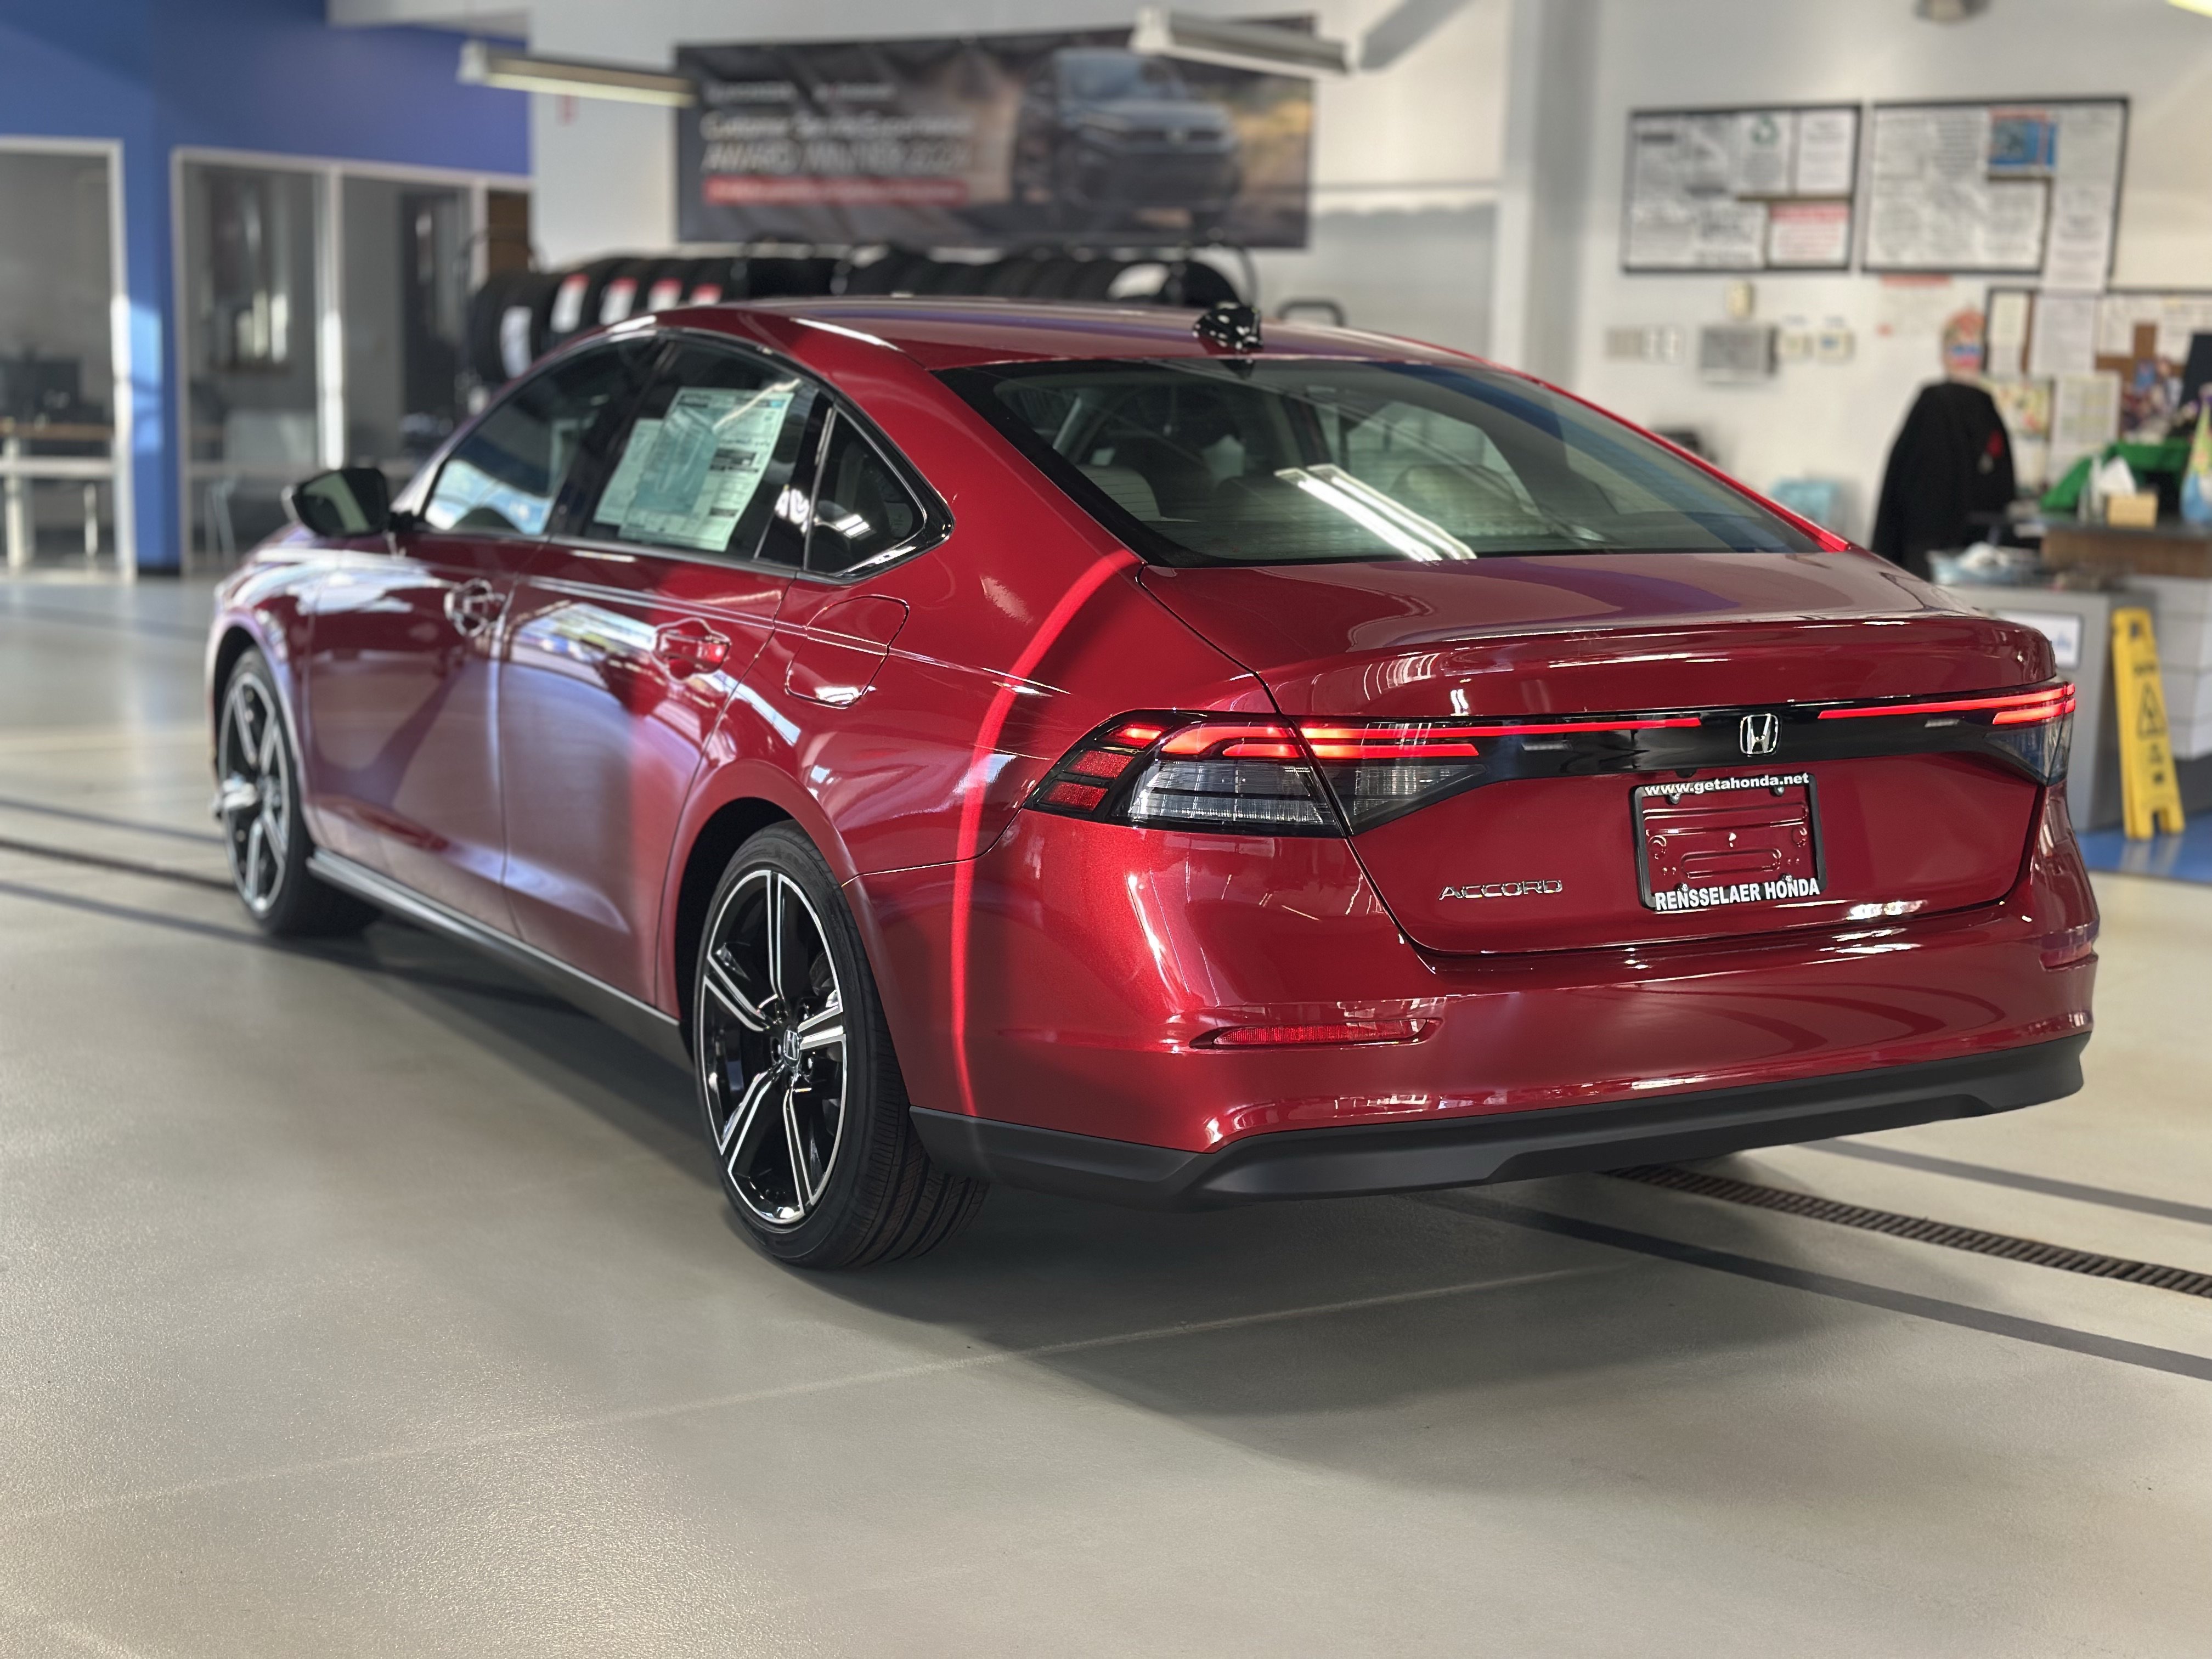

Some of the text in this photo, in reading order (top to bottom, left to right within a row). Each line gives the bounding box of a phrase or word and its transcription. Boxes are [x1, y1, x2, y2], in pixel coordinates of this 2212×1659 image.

[1645, 772, 1809, 795] www.getahonda.net
[1438, 880, 1563, 900] ACCORD
[1655, 877, 1820, 911] RENSSELAER HONDA
